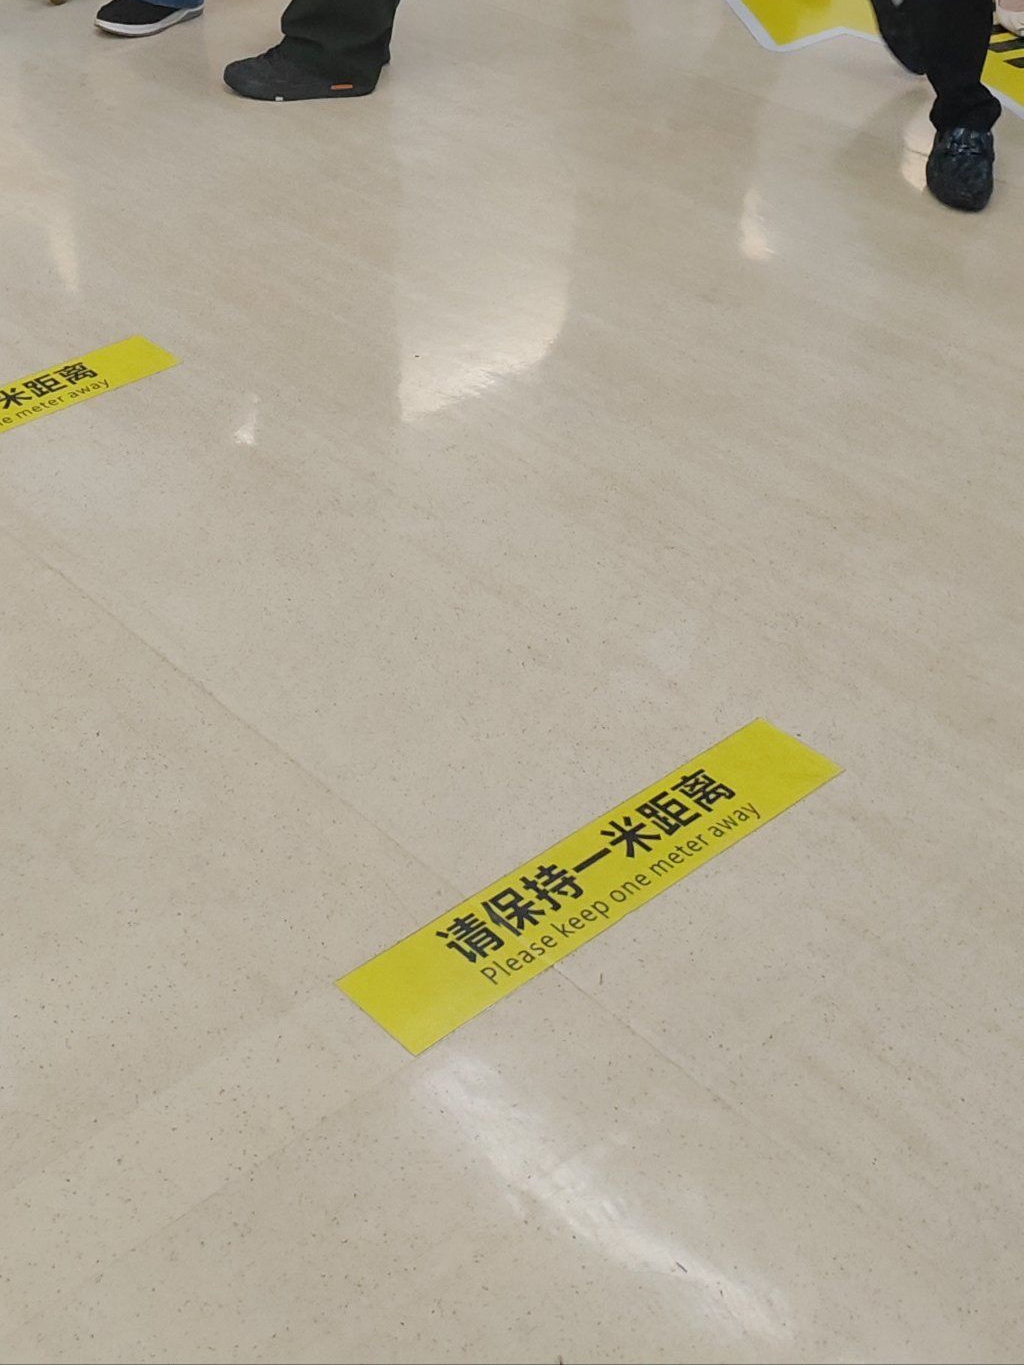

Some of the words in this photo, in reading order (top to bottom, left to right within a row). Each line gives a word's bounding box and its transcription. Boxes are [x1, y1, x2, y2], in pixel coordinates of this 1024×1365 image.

[15, 395, 66, 427] meter
[67, 376, 111, 402] away
[435, 768, 737, 964] 请保持一米距离
[479, 934, 558, 985] Please
[550, 898, 611, 939] keep
[610, 873, 652, 904] one
[649, 832, 711, 876] meter
[709, 799, 762, 840] away
